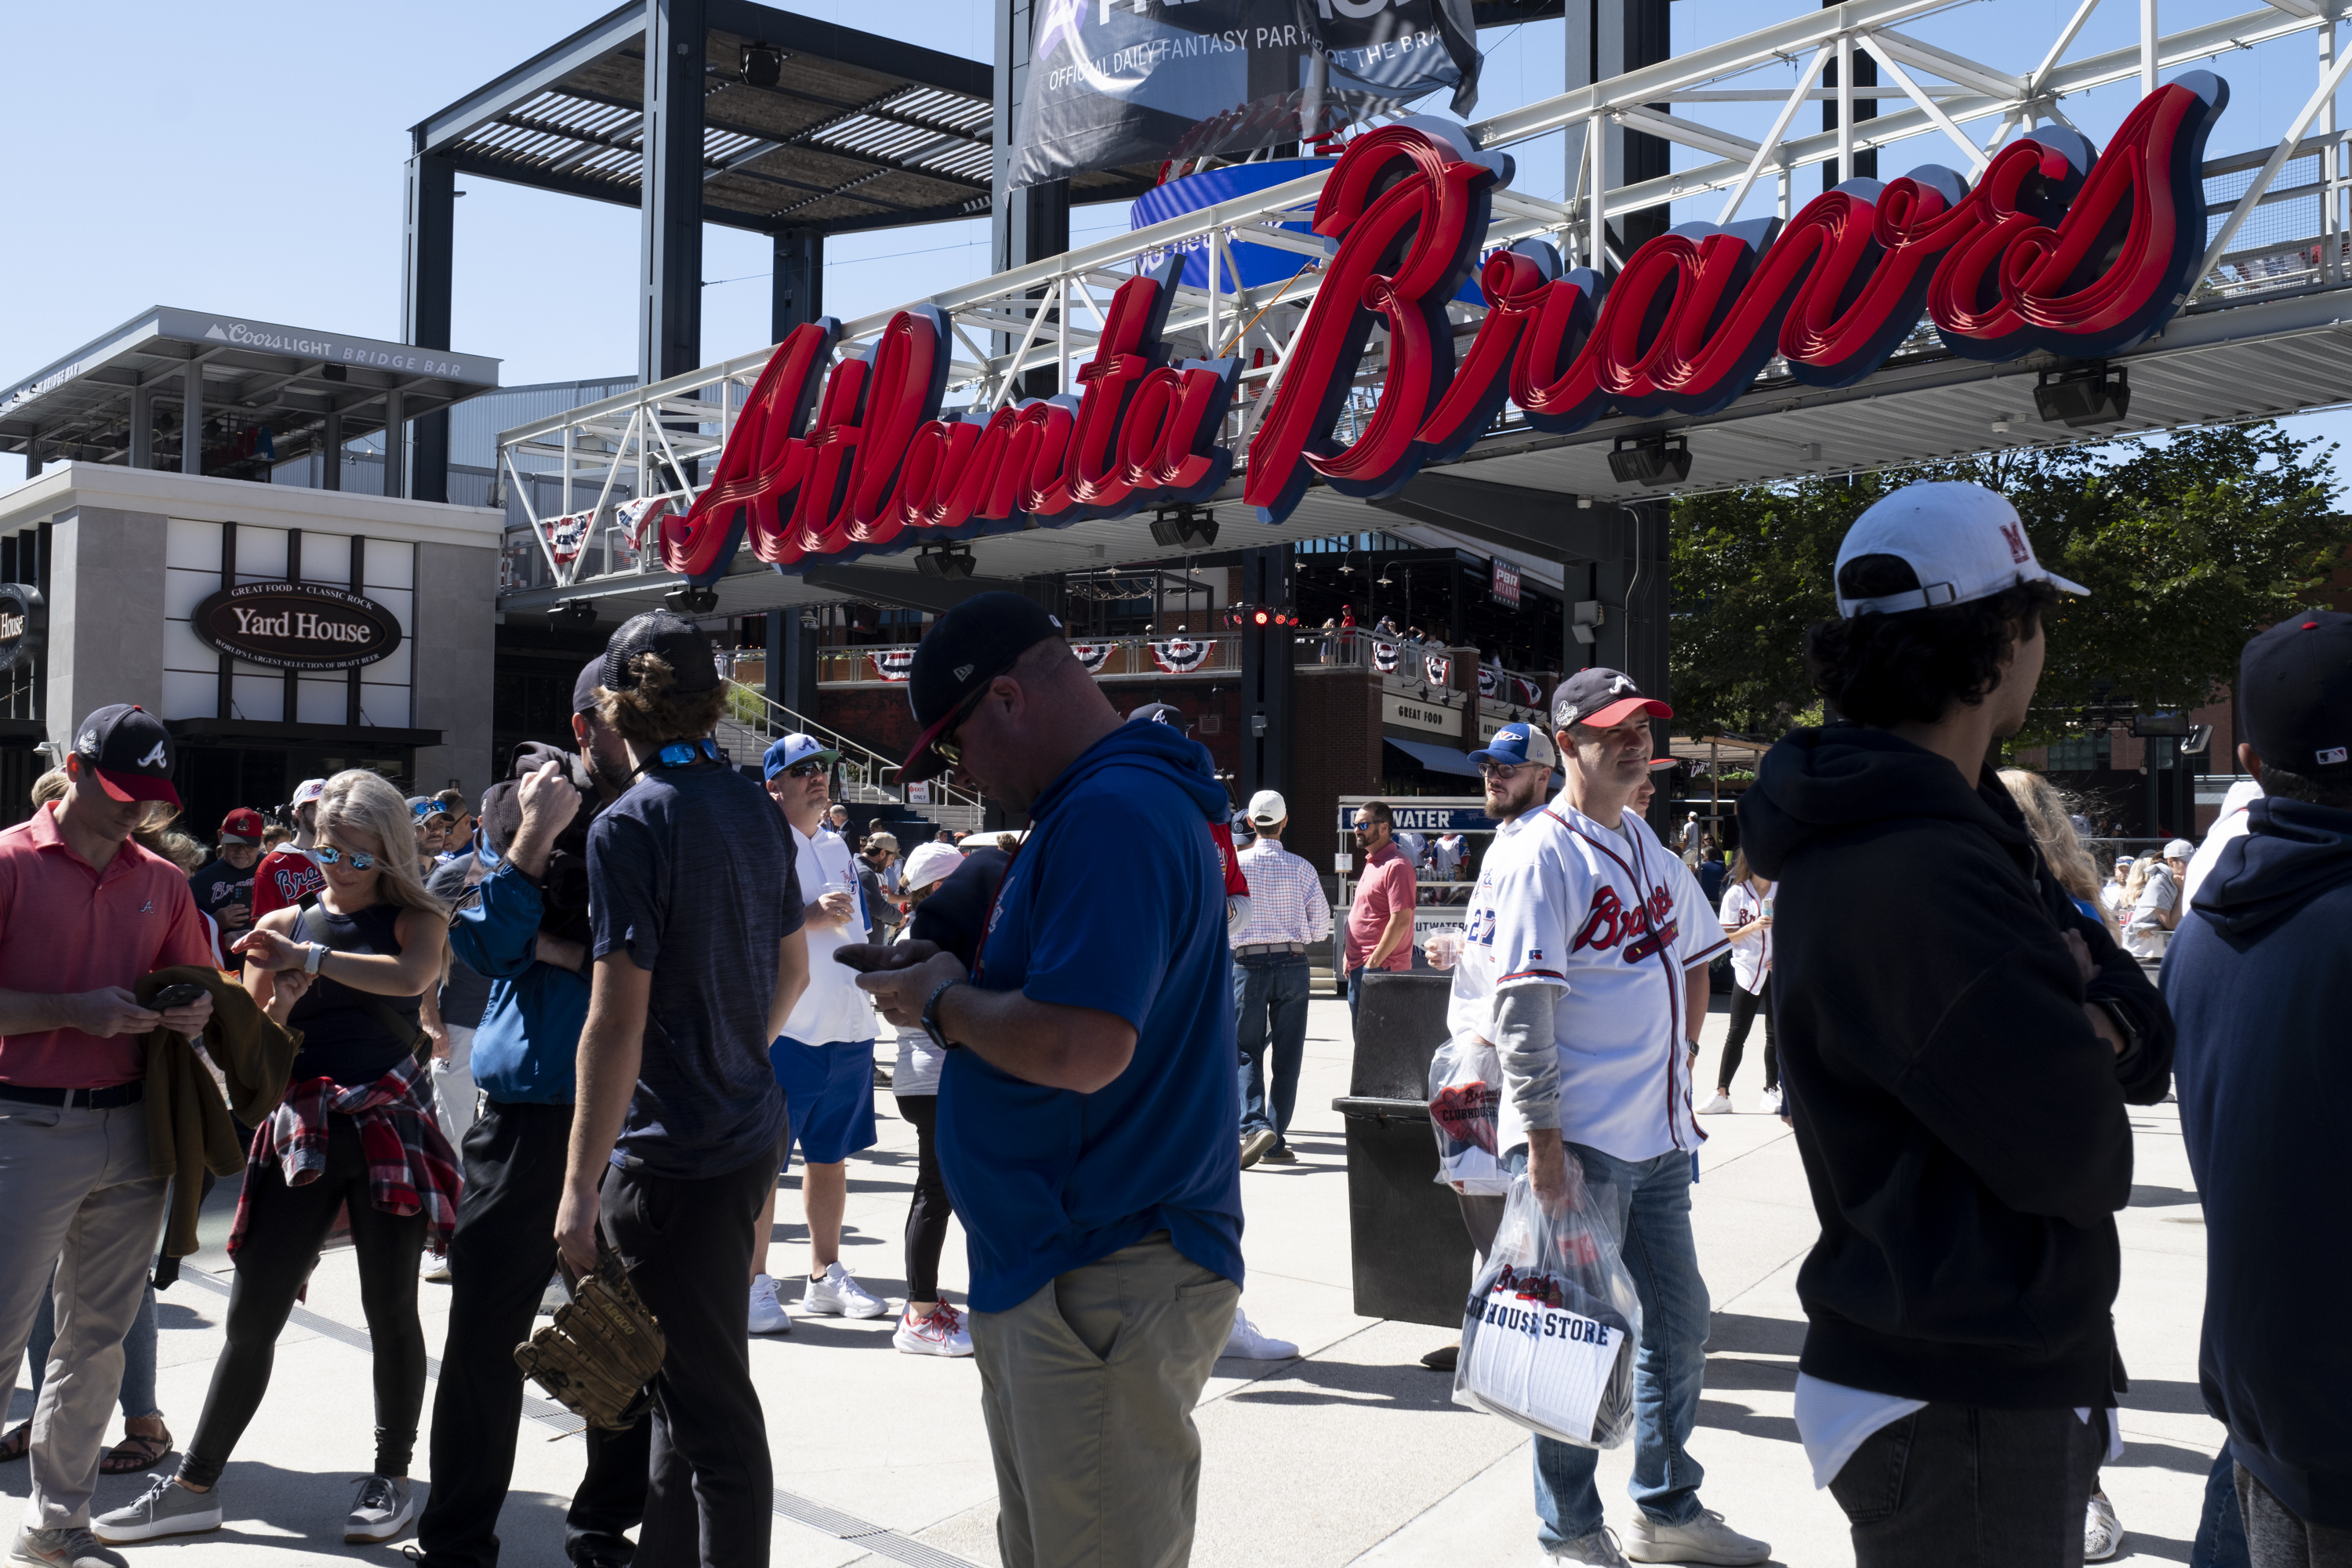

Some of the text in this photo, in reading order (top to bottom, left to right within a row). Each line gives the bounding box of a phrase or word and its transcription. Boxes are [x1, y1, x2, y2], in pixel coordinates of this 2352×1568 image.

[1114, 42, 1156, 74] DAILY
[1162, 29, 1249, 61] FANTASY
[1325, 49, 1348, 68] OF
[1352, 42, 1396, 68] THE
[1400, 21, 1441, 53] BRA
[659, 71, 2225, 580] Atlanta Braves
[228, 322, 461, 377] Coors LIGHT BRIDGE BAR
[42, 362, 79, 394] BRIDGE BAR
[1999, 521, 2027, 557] M
[1495, 582, 1519, 599] ATLANTA
[1497, 568, 1518, 587] PBR
[231, 585, 263, 597] GREAT
[307, 586, 345, 601] CLASSIC
[347, 595, 375, 610] ROCK
[1, 612, 25, 639] House
[232, 607, 371, 643] Yard House
[216, 638, 247, 657] WORLD'S
[248, 653, 281, 666] LARGEST
[283, 660, 325, 669] SELECTION
[336, 659, 360, 668] DRAFT
[361, 653, 379, 664] BEER
[1399, 706, 1443, 725] GREAT FOOD
[137, 740, 167, 769] A
[275, 866, 323, 906] Bra
[1467, 907, 1496, 947] 27
[1571, 874, 1674, 955] Braves
[1443, 1106, 1498, 1121] CLUBHOUSE
[1493, 1264, 1552, 1293] Braves
[601, 1302, 636, 1335] A2000
[1544, 1313, 1610, 1345] STORE
